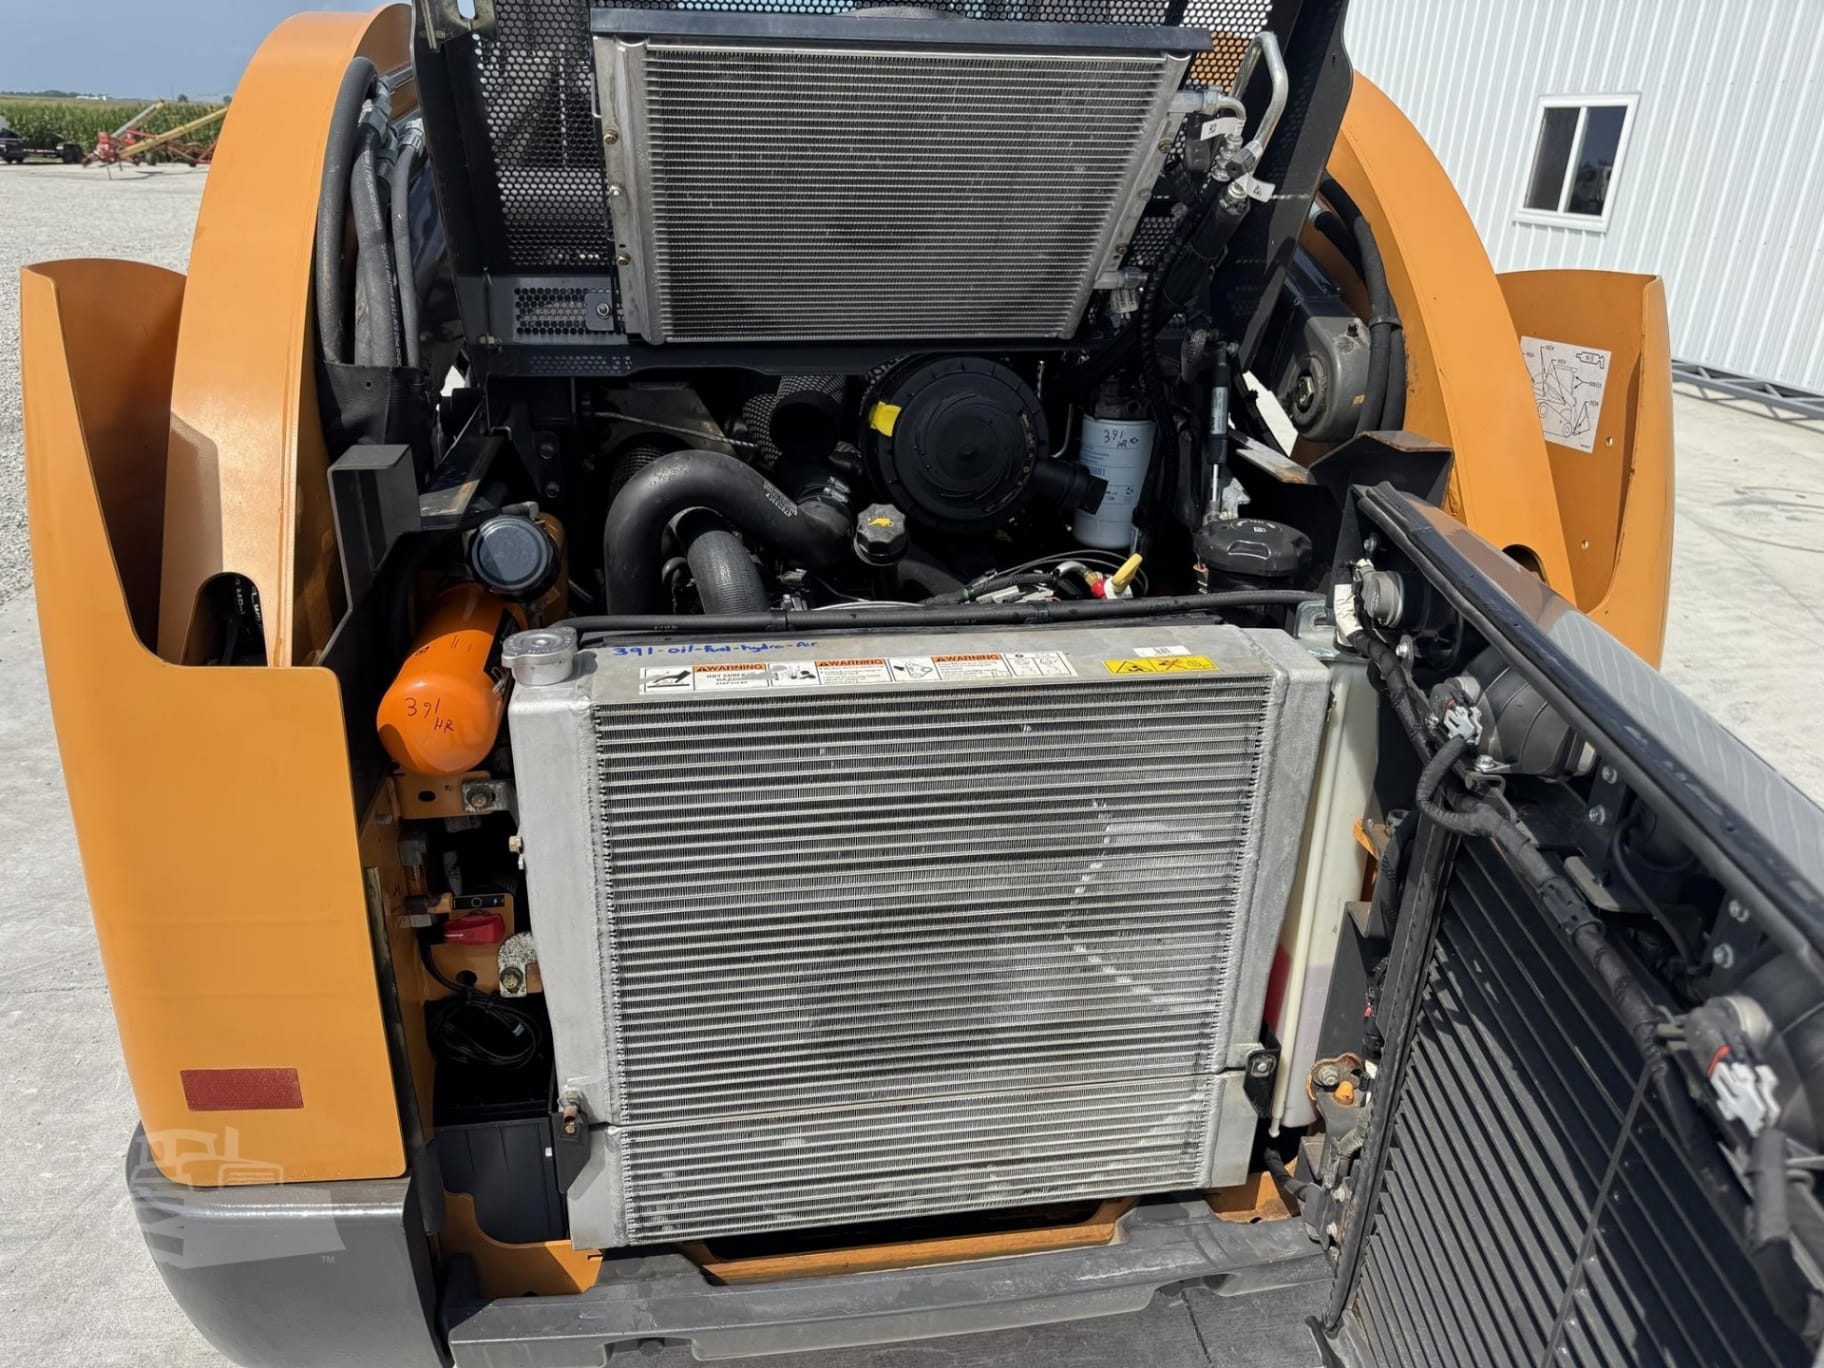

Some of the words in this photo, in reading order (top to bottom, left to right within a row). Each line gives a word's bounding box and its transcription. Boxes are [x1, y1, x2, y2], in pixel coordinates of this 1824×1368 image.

[1104, 428, 1124, 443] 391
[829, 658, 884, 667] WARNING
[946, 653, 1000, 662] WARNING
[706, 663, 764, 672] WARNING
[404, 697, 441, 718] 391
[433, 717, 455, 733] HR
